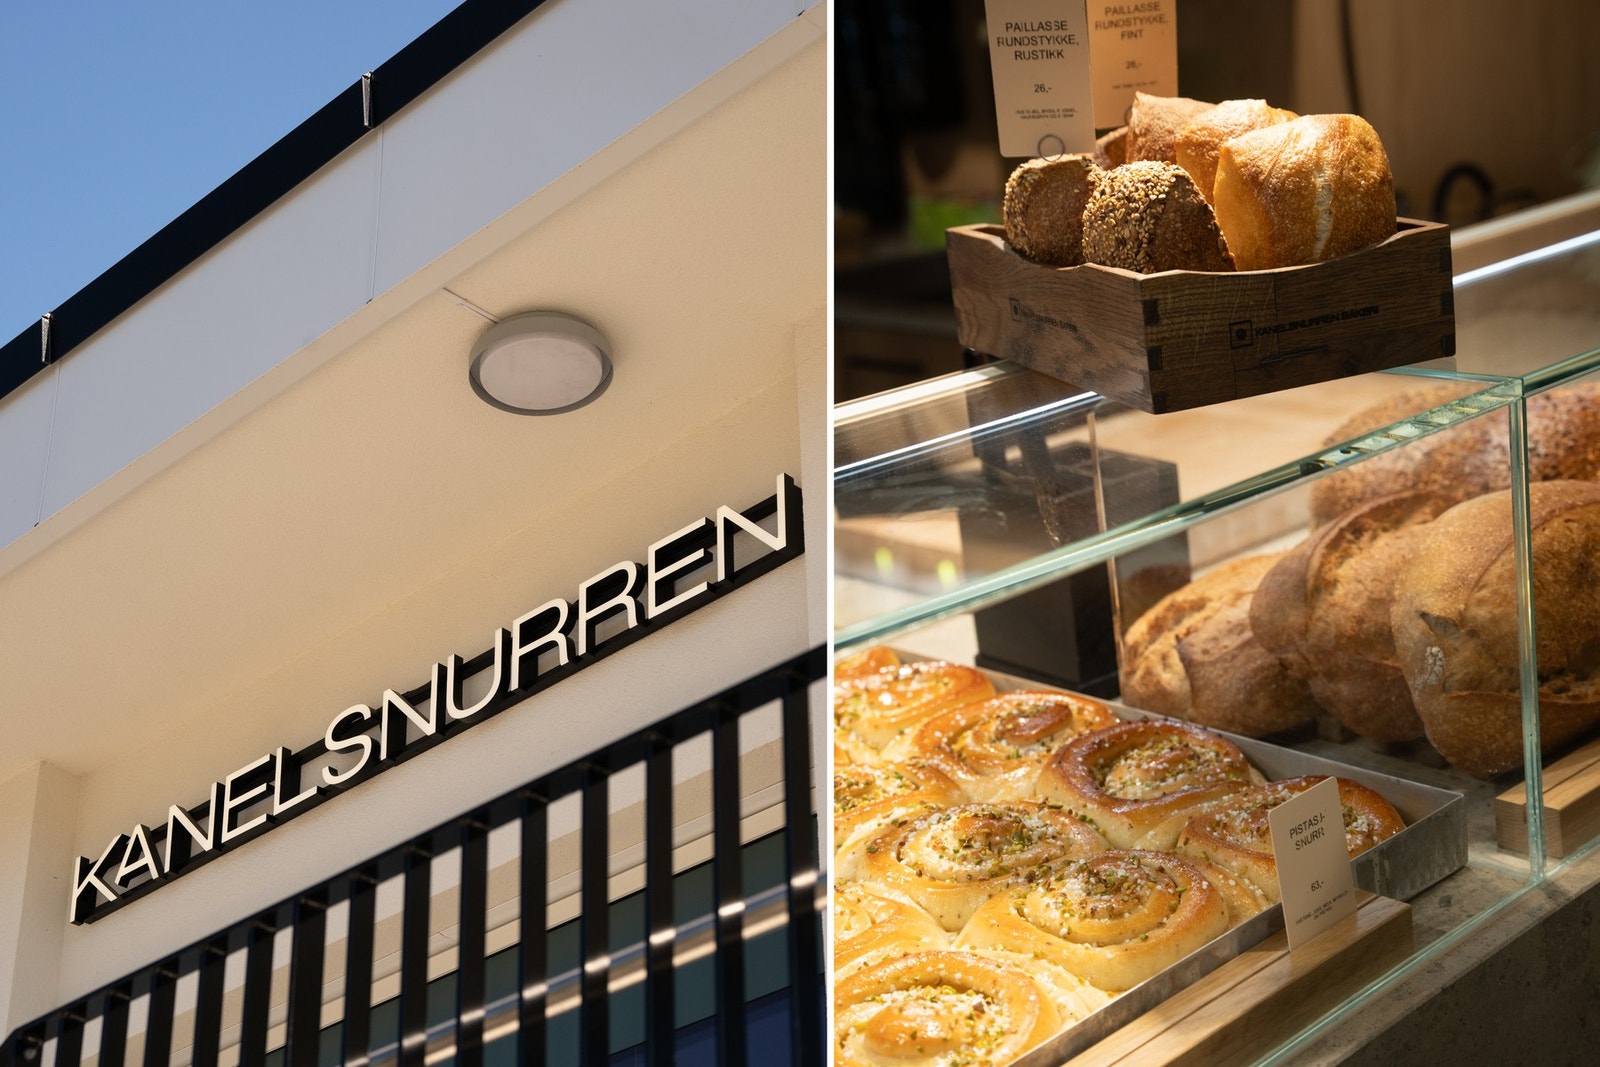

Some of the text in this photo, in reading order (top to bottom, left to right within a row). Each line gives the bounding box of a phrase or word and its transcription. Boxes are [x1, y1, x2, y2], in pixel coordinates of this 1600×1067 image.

[1104, 3, 1160, 16] PAILLASSE
[1005, 20, 1068, 32] PAILLASSE
[1095, 15, 1169, 31] RUNDSTYKKE,
[997, 34, 1079, 47] RUNDSTYKKE,
[1121, 29, 1143, 40] FINT
[1014, 49, 1064, 61] RUSTIKK
[1034, 83, 1052, 93] 26,-
[1255, 305, 1379, 337] KANELSNURREN BAKERI
[70, 473, 796, 924] KANELSNURREN
[1310, 880, 1325, 892] 63,-
